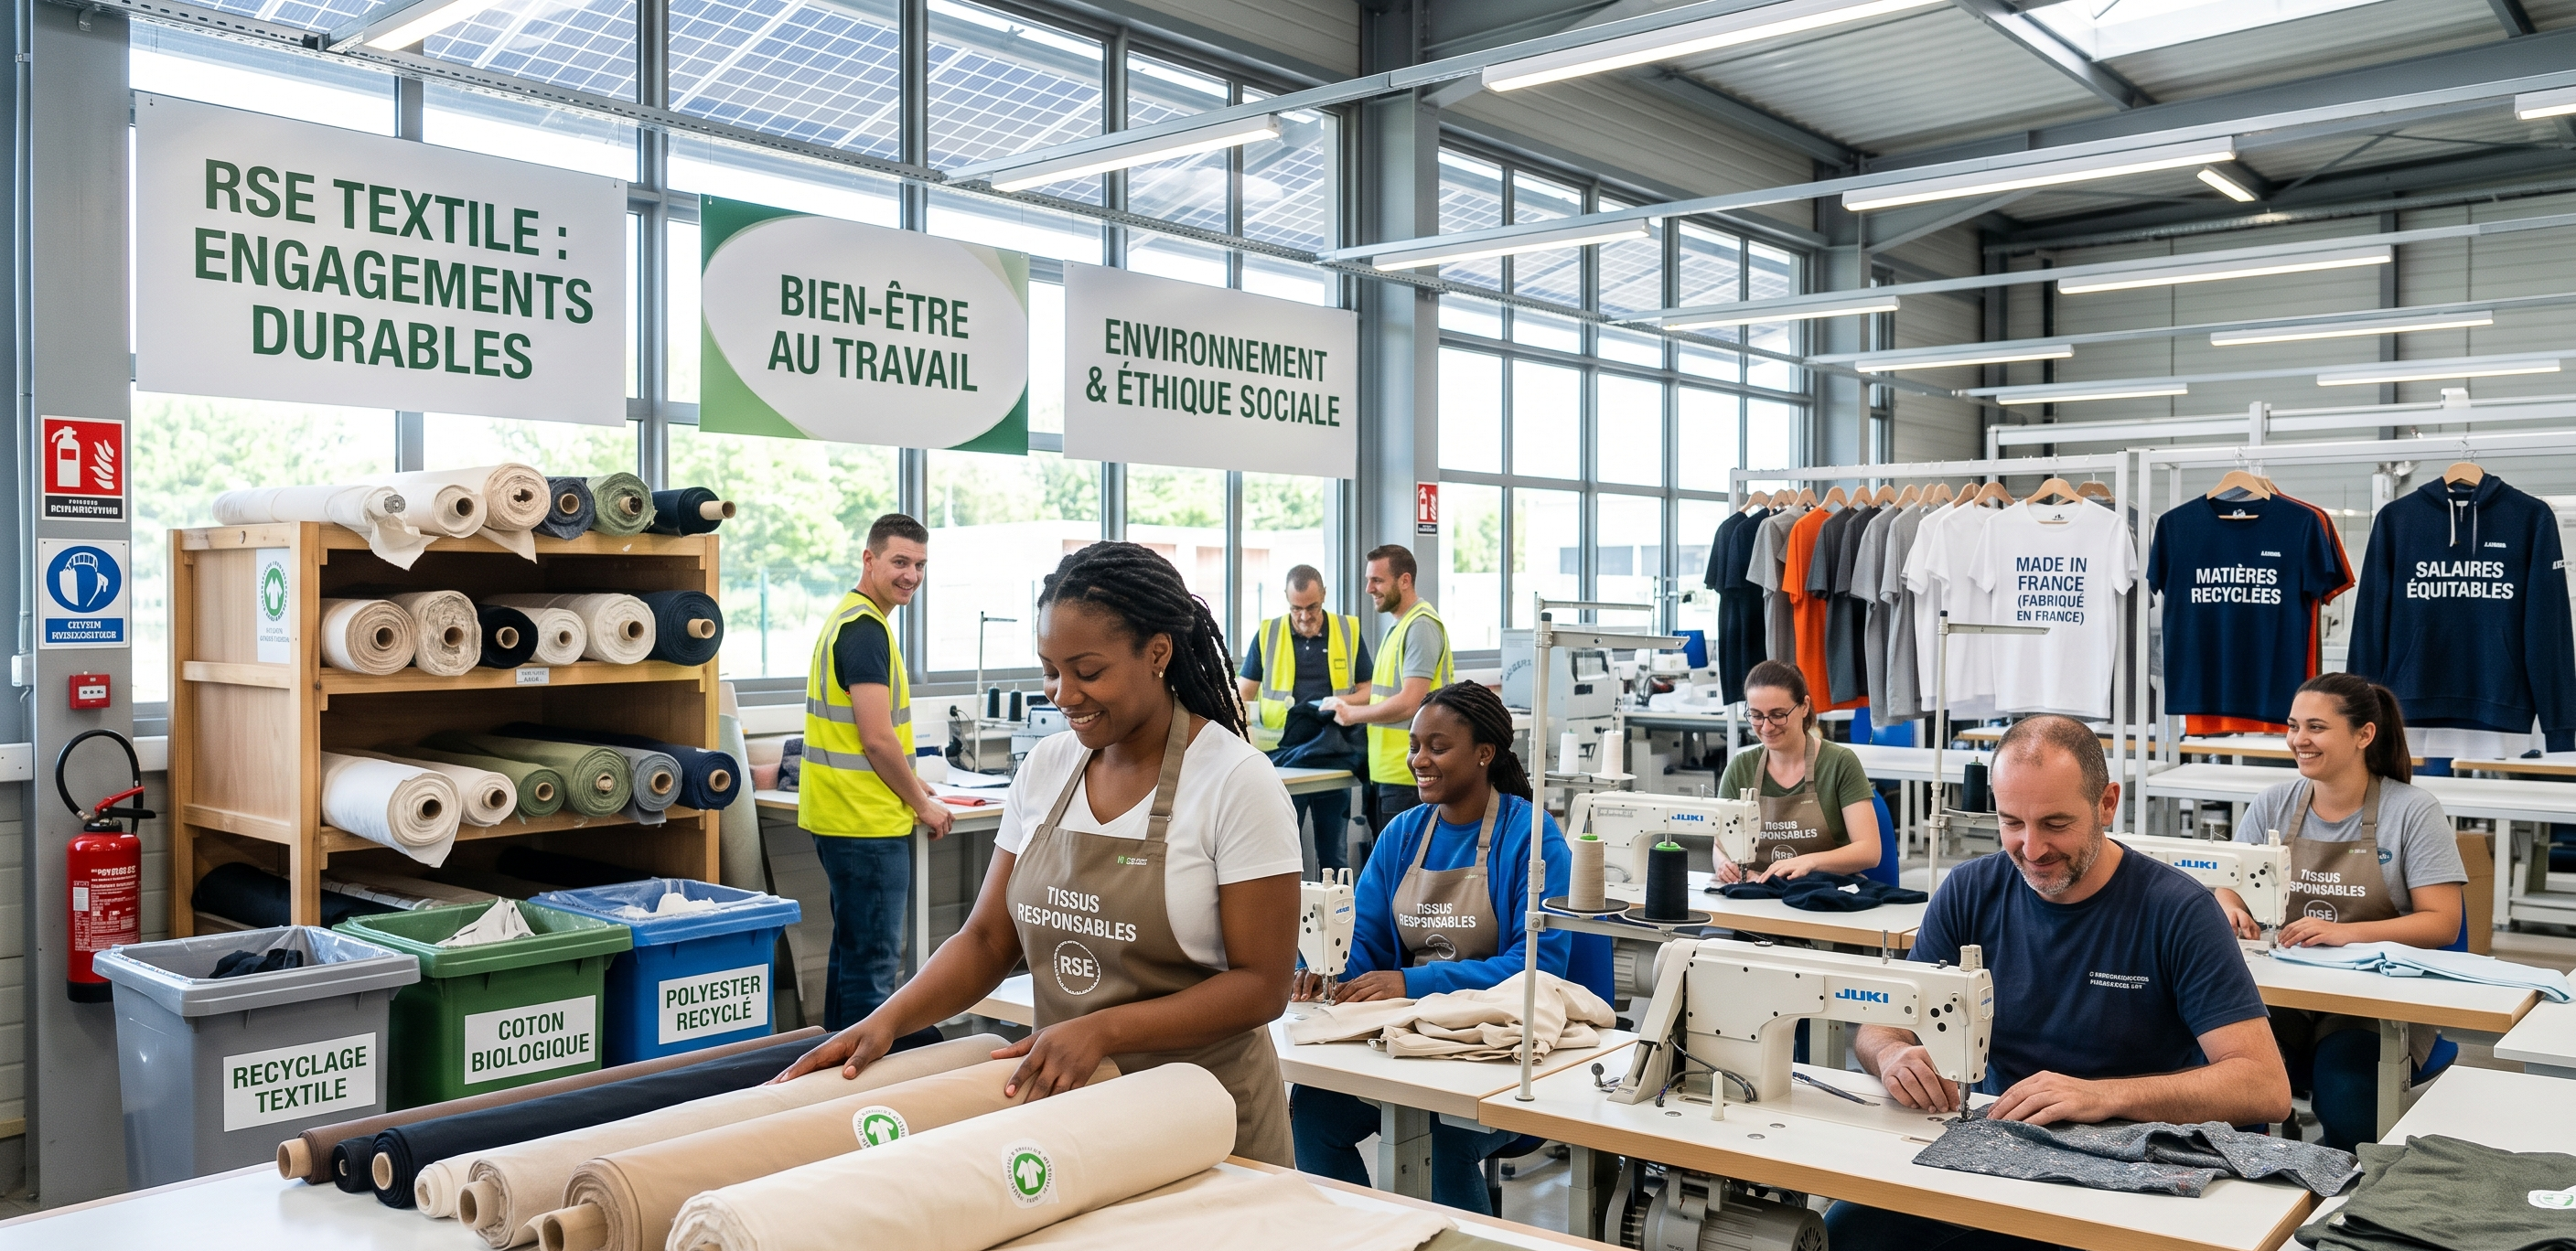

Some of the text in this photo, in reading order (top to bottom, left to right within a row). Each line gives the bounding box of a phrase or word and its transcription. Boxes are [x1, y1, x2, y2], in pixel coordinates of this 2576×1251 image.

[206, 159, 566, 260] RSE TEXTILE :
[196, 228, 593, 325] ENGAGEMENTS
[782, 274, 968, 339] BIEN-ÊTRE
[253, 305, 531, 379] DURABLES
[1106, 318, 1326, 383] ENVIRONNEMENT
[767, 331, 977, 391] AU TRAVAIL
[1086, 361, 1339, 427] & ÉTHIQUE SOCIALE
[2017, 557, 2087, 572] MADE IN
[2196, 563, 2277, 587] MATIÈRES
[2416, 561, 2504, 578] SALAIRES
[2019, 576, 2084, 592] FRANCE
[2408, 578, 2514, 600] ÉQUITABLES
[2018, 593, 2084, 608] (FABRIQUÉ
[2017, 611, 2084, 626] EN FRANCE)
[2174, 860, 2216, 869] JUKI
[2301, 869, 2340, 883] TISSUS
[1047, 886, 1099, 913] TISSUS
[2290, 881, 2366, 897] SPONSABLES
[1018, 903, 1136, 941] RESPONSABLES
[1061, 955, 1097, 978] RSE
[667, 976, 760, 1009] POLYESTER
[1836, 989, 1888, 1003] JUKI
[499, 1011, 564, 1040] COTON
[675, 995, 751, 1031] RECYCLÉ
[472, 1032, 590, 1073] BIOLOGIQUE
[233, 1046, 366, 1090] RECYCLAGE
[254, 1077, 346, 1113] TEXTILE
